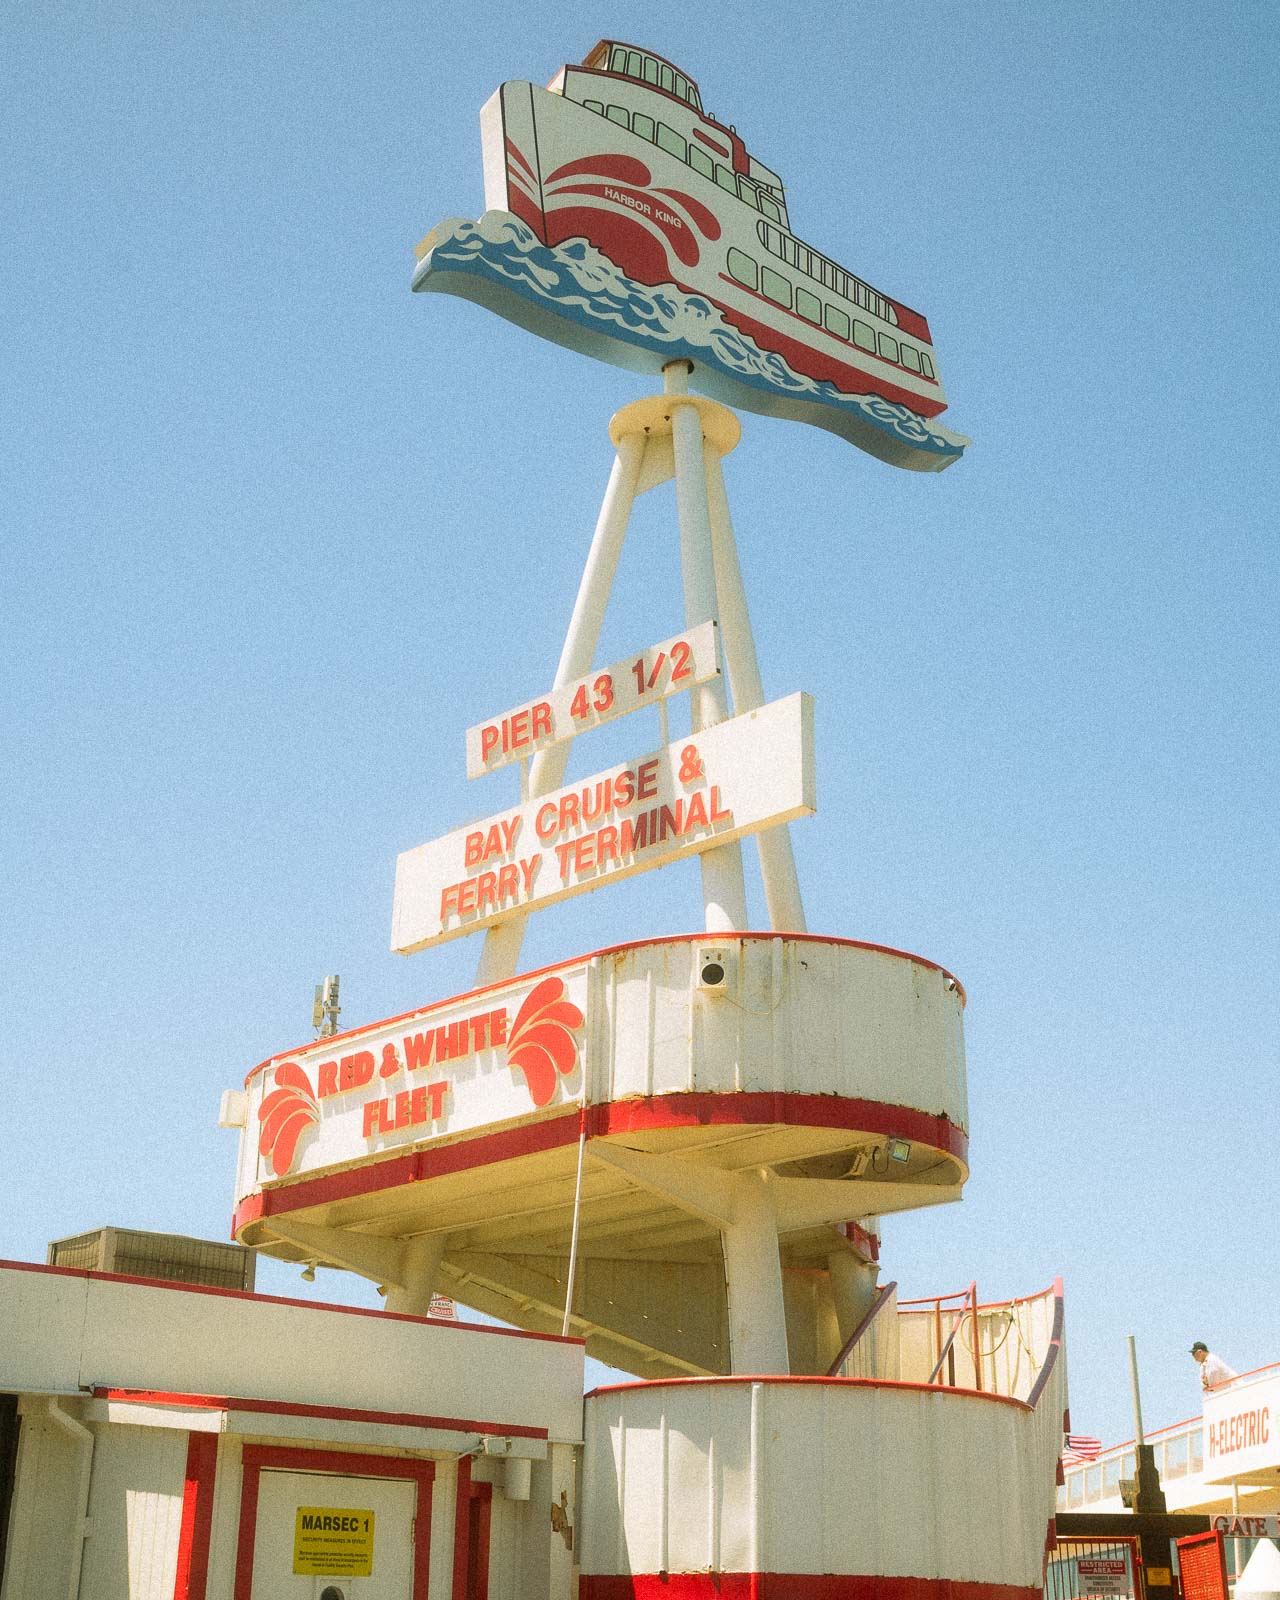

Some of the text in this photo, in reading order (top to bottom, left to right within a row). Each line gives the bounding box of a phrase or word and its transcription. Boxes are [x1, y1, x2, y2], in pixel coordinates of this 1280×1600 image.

[604, 186, 682, 229] HARBOR KING
[481, 641, 691, 763] PIER 43 1/2
[464, 744, 705, 870] BAY CRUISE &
[440, 786, 733, 923] FERRY TERMINAL
[317, 1007, 509, 1099] RED & WHITE
[362, 1081, 448, 1138] FLEET
[302, 1515, 369, 1532] MARSEC 1
[1212, 1515, 1268, 1536] GATE
